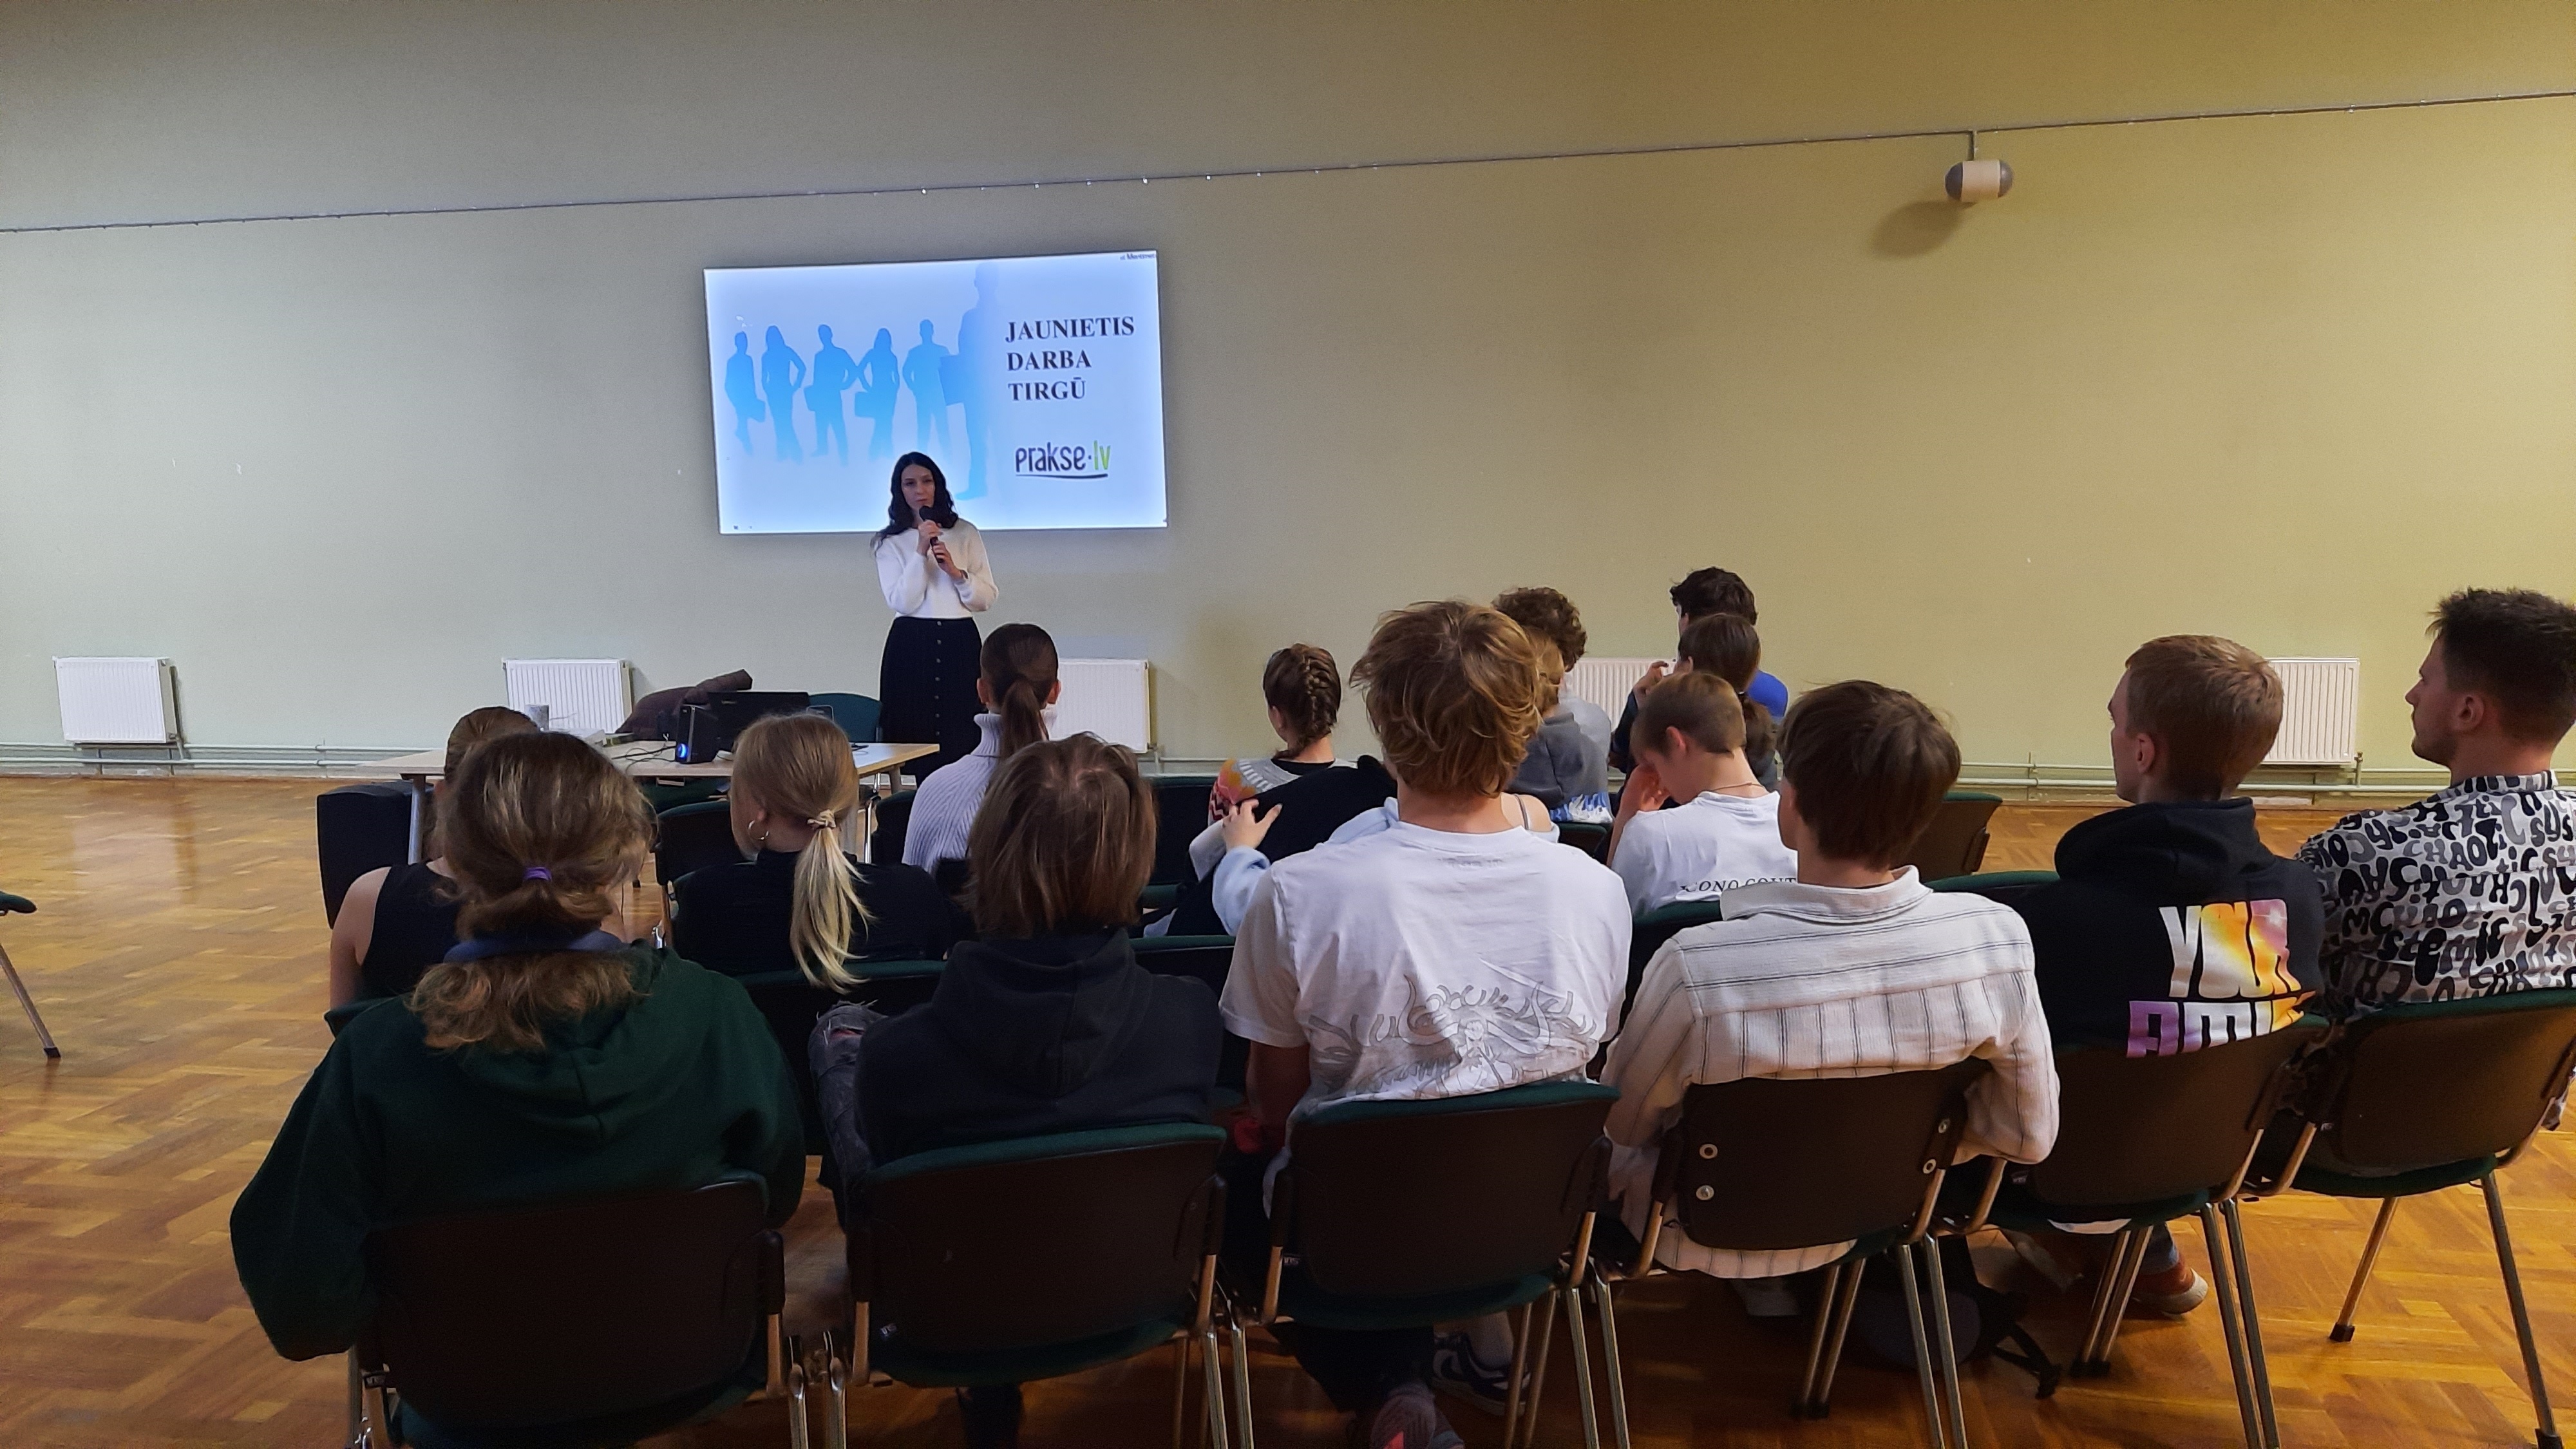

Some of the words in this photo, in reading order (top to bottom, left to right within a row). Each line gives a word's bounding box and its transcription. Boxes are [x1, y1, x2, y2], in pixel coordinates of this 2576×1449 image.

[1005, 316, 1135, 343] JAUNIETIS
[1007, 349, 1092, 372] DARBA
[1007, 377, 1086, 401] TIRGŪ
